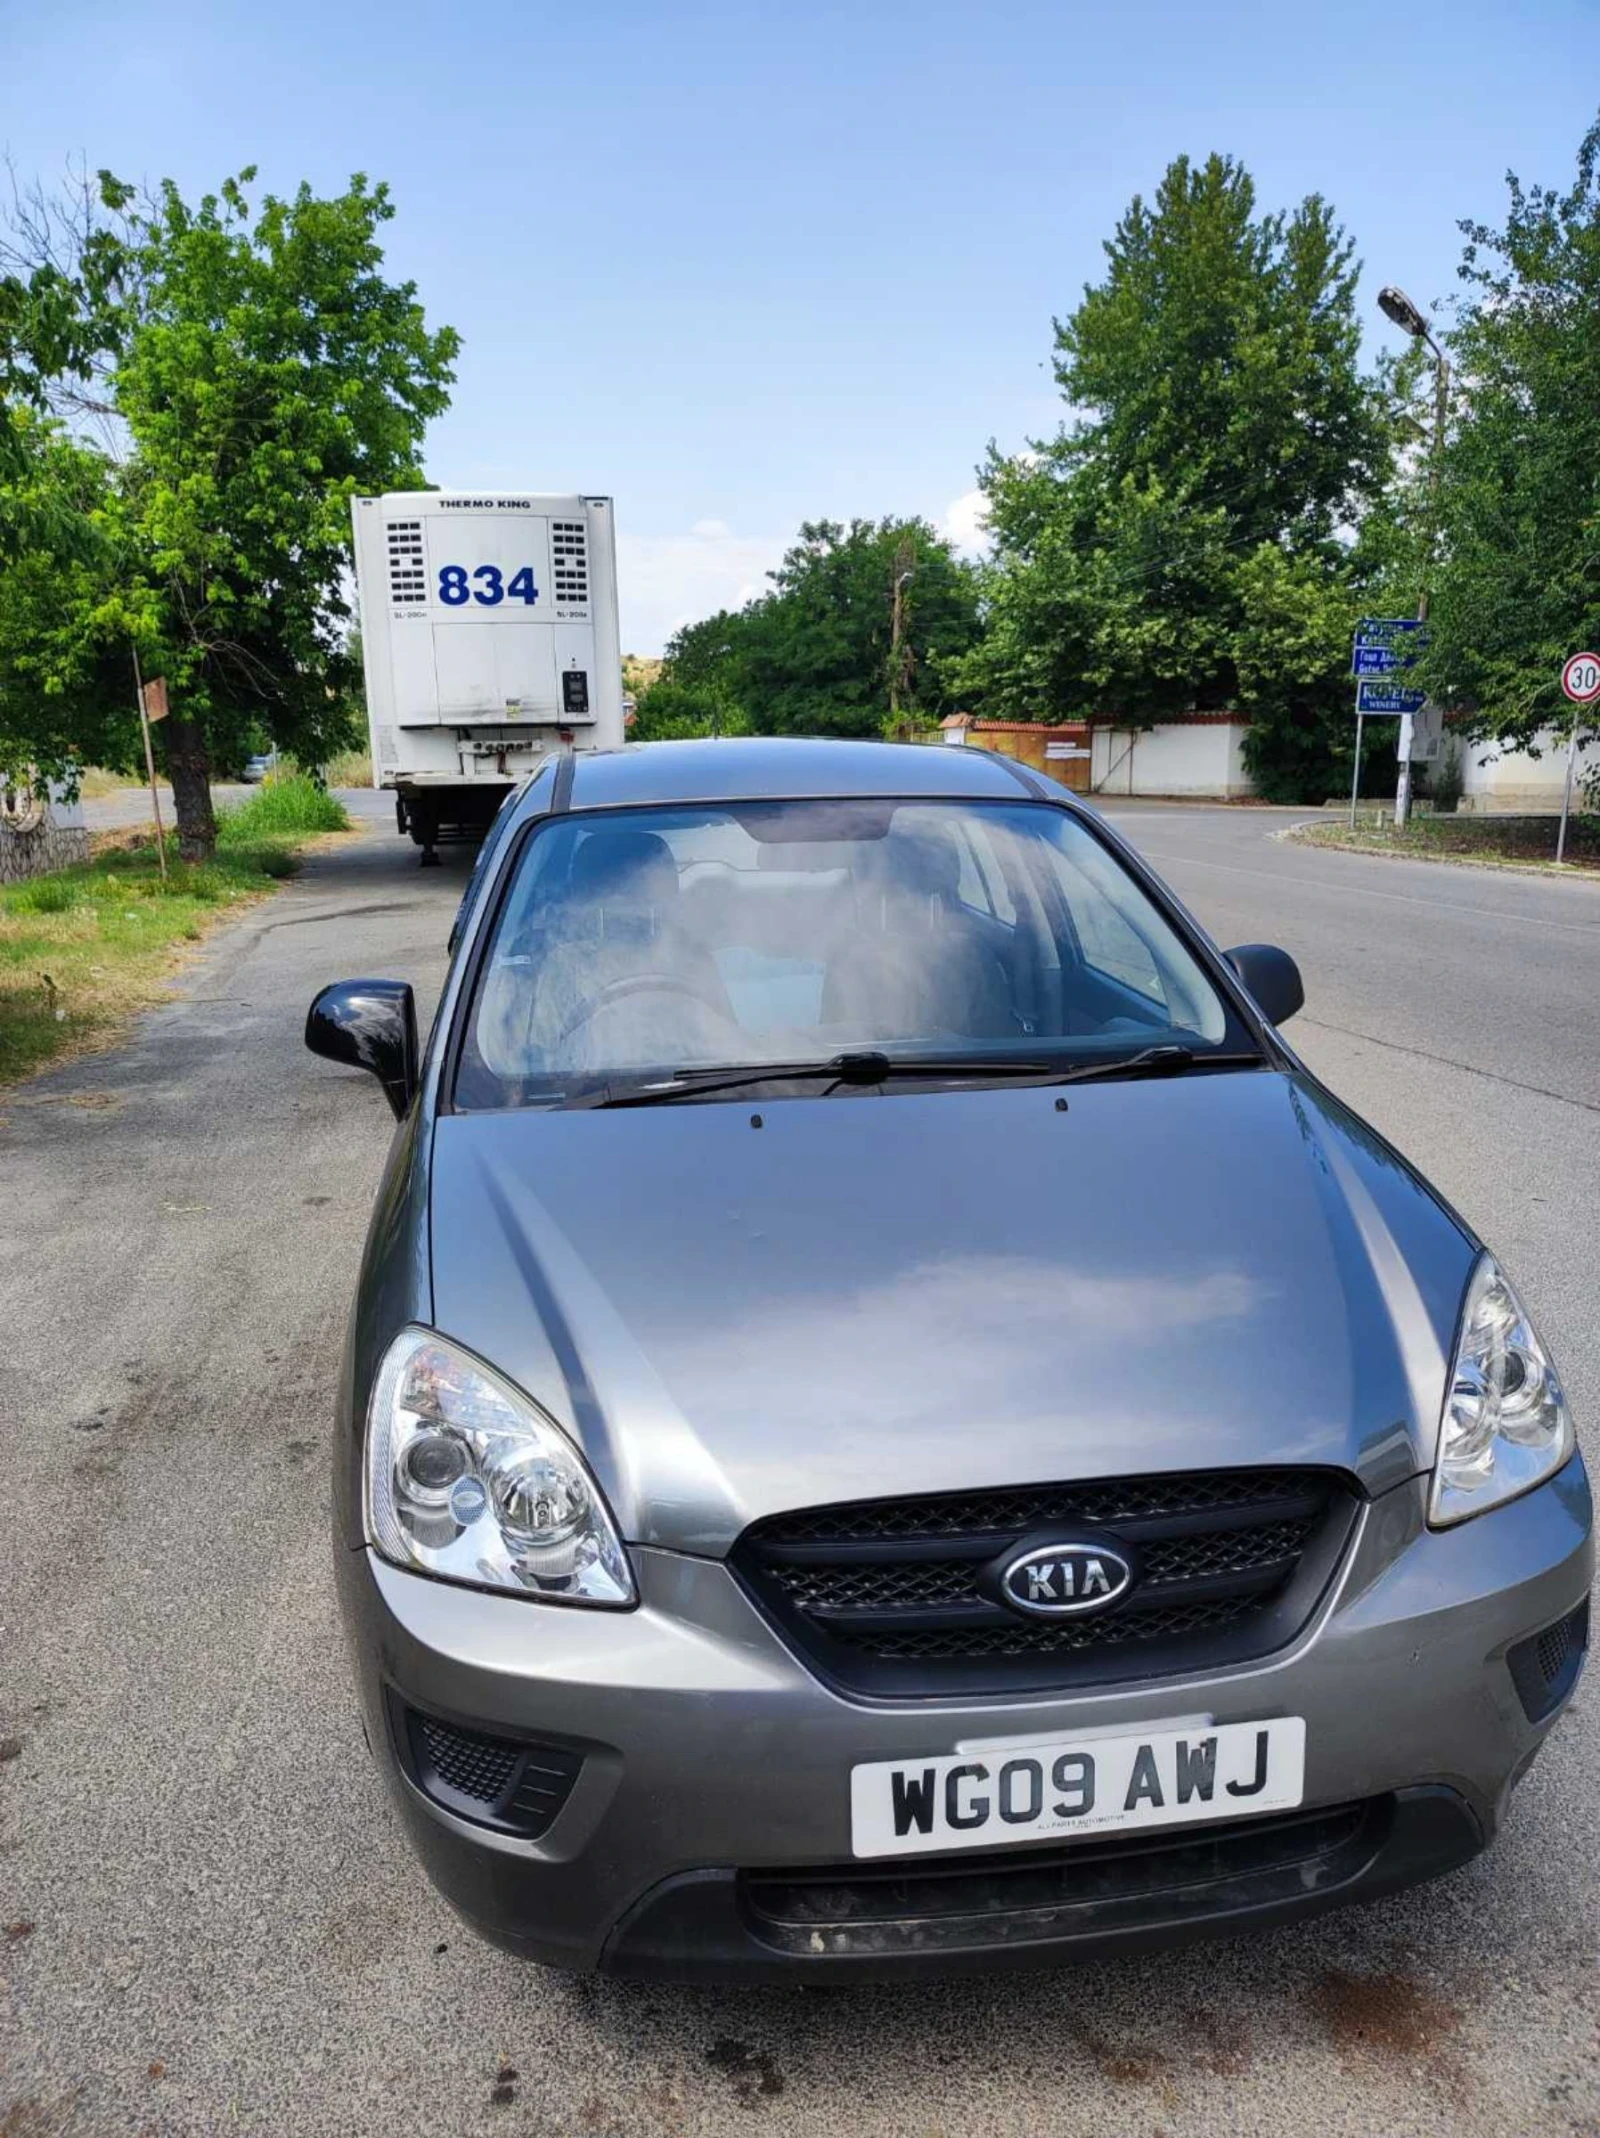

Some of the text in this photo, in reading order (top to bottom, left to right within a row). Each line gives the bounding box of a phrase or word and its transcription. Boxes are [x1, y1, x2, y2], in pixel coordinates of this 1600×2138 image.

[439, 500, 531, 509] THERMO KING
[438, 564, 539, 606] 834
[1572, 666, 1596, 689] 30
[1025, 1559, 1112, 1600] KIA
[891, 1730, 1269, 1837] WG09 AWJ
